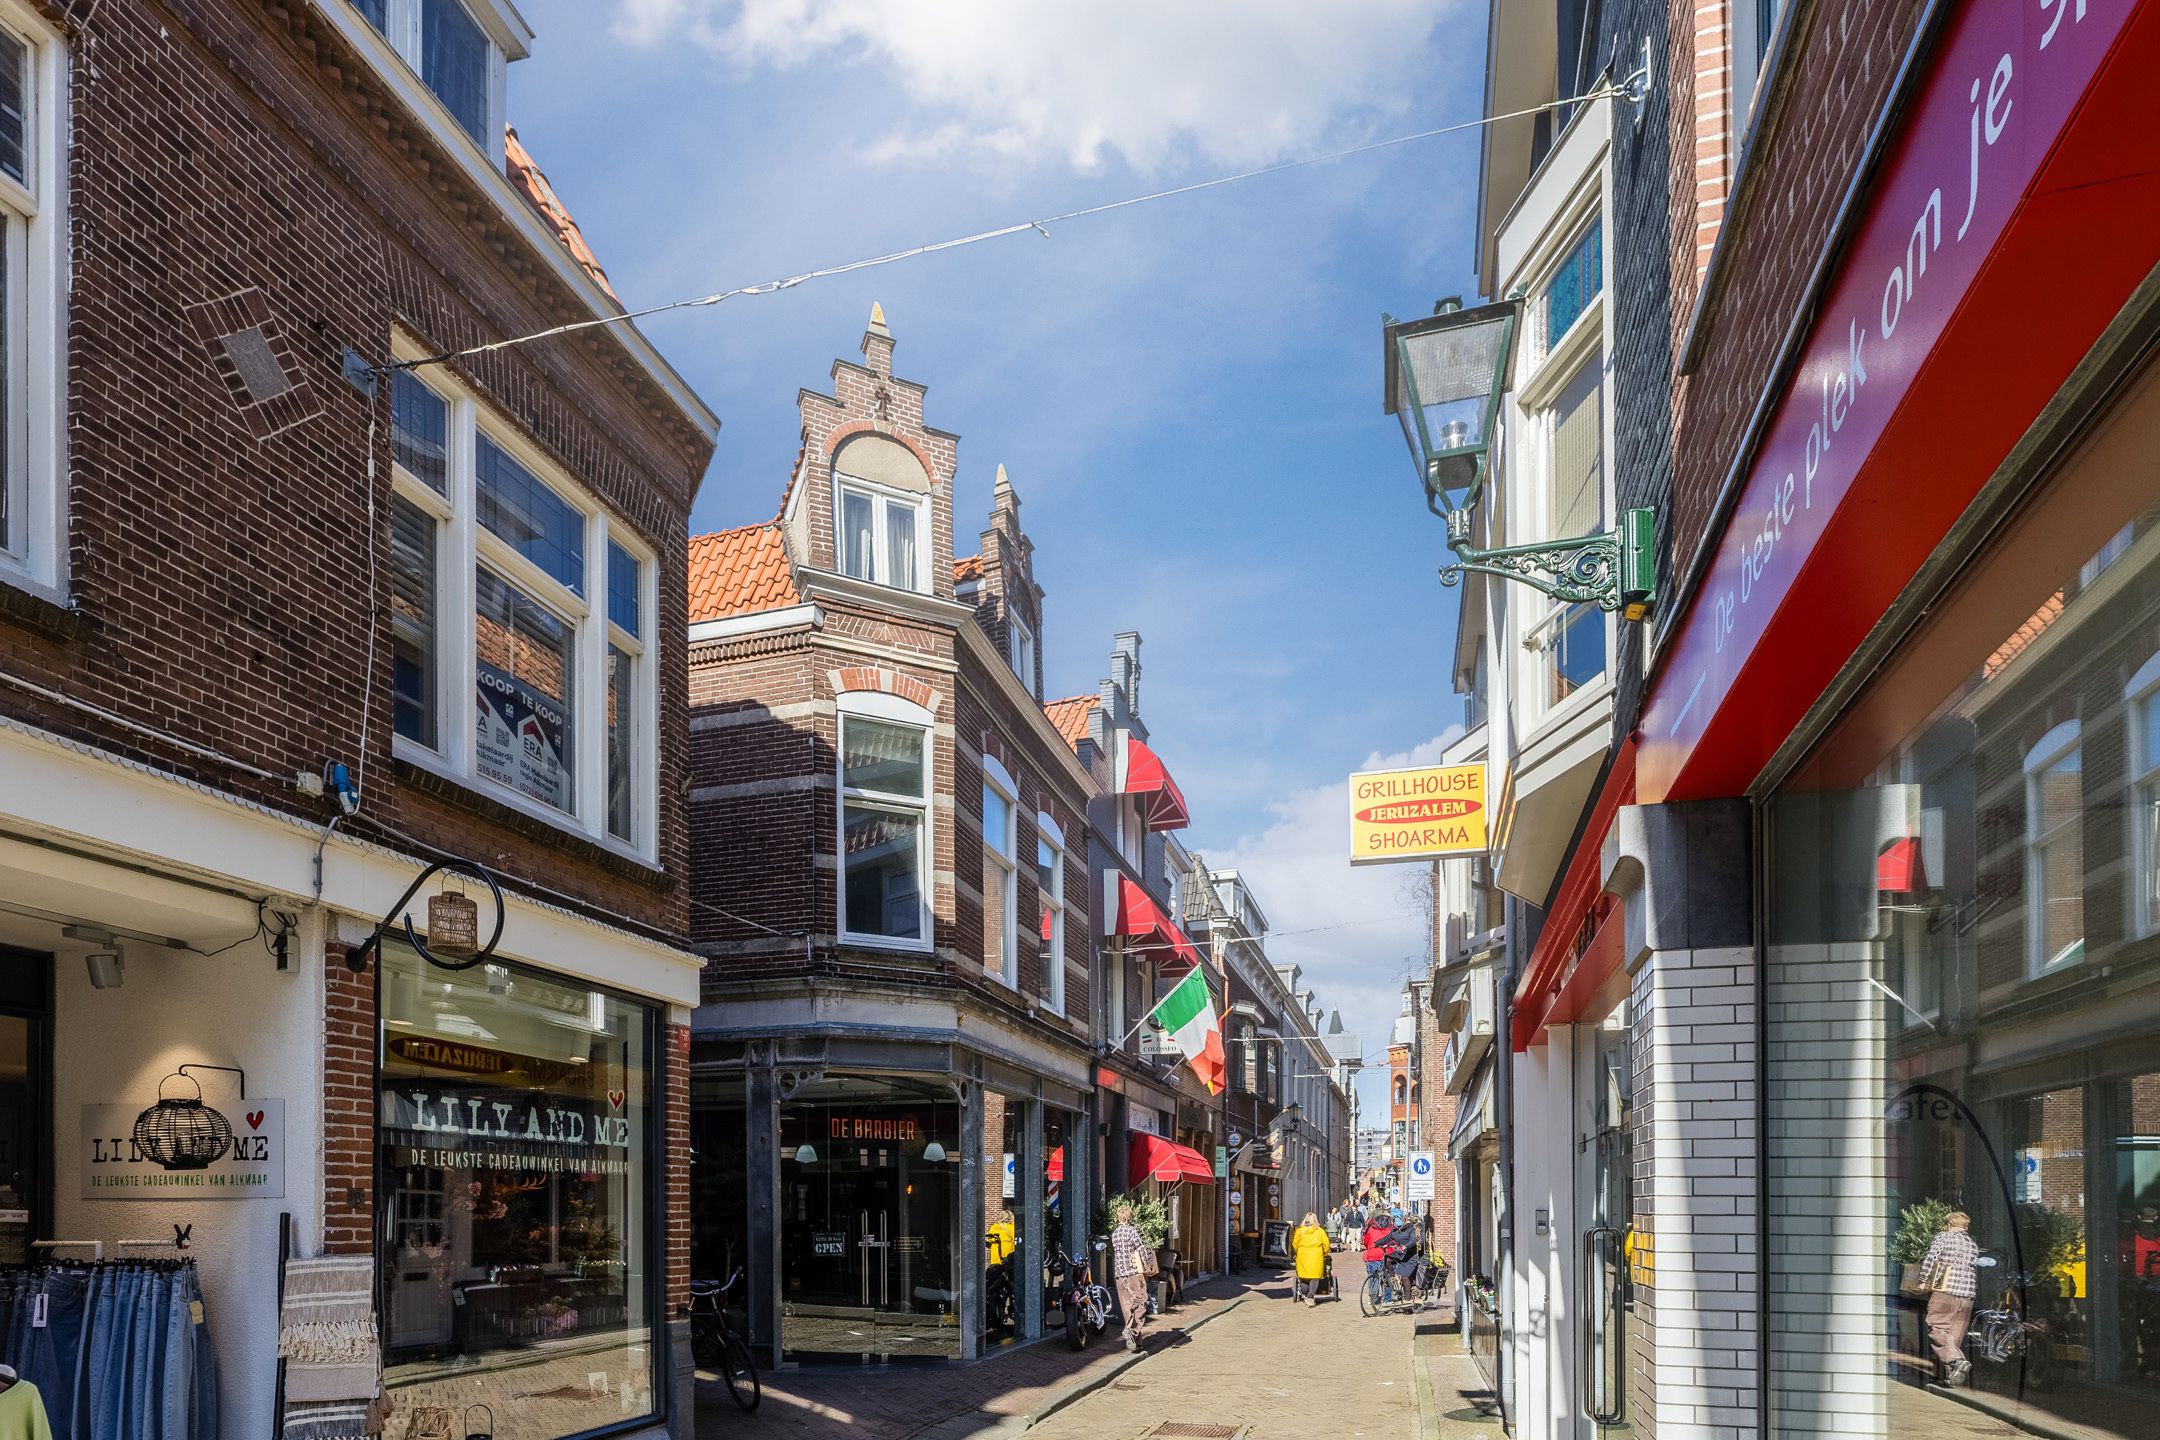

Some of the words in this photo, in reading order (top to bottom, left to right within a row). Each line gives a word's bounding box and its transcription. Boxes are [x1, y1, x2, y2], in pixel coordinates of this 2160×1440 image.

[1715, 590, 1735, 655] De
[1740, 472, 1795, 604] beste
[1805, 316, 1868, 509] plek
[1881, 188, 1941, 340] om
[1957, 53, 2013, 242] je
[476, 669, 514, 696] KOOP
[521, 692, 534, 710] TE
[535, 701, 562, 727] KOOP
[523, 737, 542, 759] ERA
[1358, 773, 1478, 799] GRILLHOUSE
[1369, 801, 1468, 821] JERUZALEM
[1370, 826, 1469, 850] SHOARMA
[411, 1093, 512, 1137] LILY
[525, 1106, 585, 1144] AND
[594, 1115, 629, 1147] ME
[831, 1118, 848, 1138] DE
[855, 1119, 914, 1140] BARBIER
[233, 1136, 268, 1161] ME
[411, 1149, 427, 1165] DE
[434, 1151, 482, 1169] LEUKSTE
[489, 1154, 564, 1174] CADEAUWINKEL
[569, 1158, 587, 1174] VAN
[92, 1176, 102, 1187] DE
[106, 1175, 139, 1187] LEUKSTE
[143, 1174, 204, 1187] CADEAUWINKEL
[209, 1174, 225, 1186] VAN
[815, 1242, 843, 1254] OPEN
